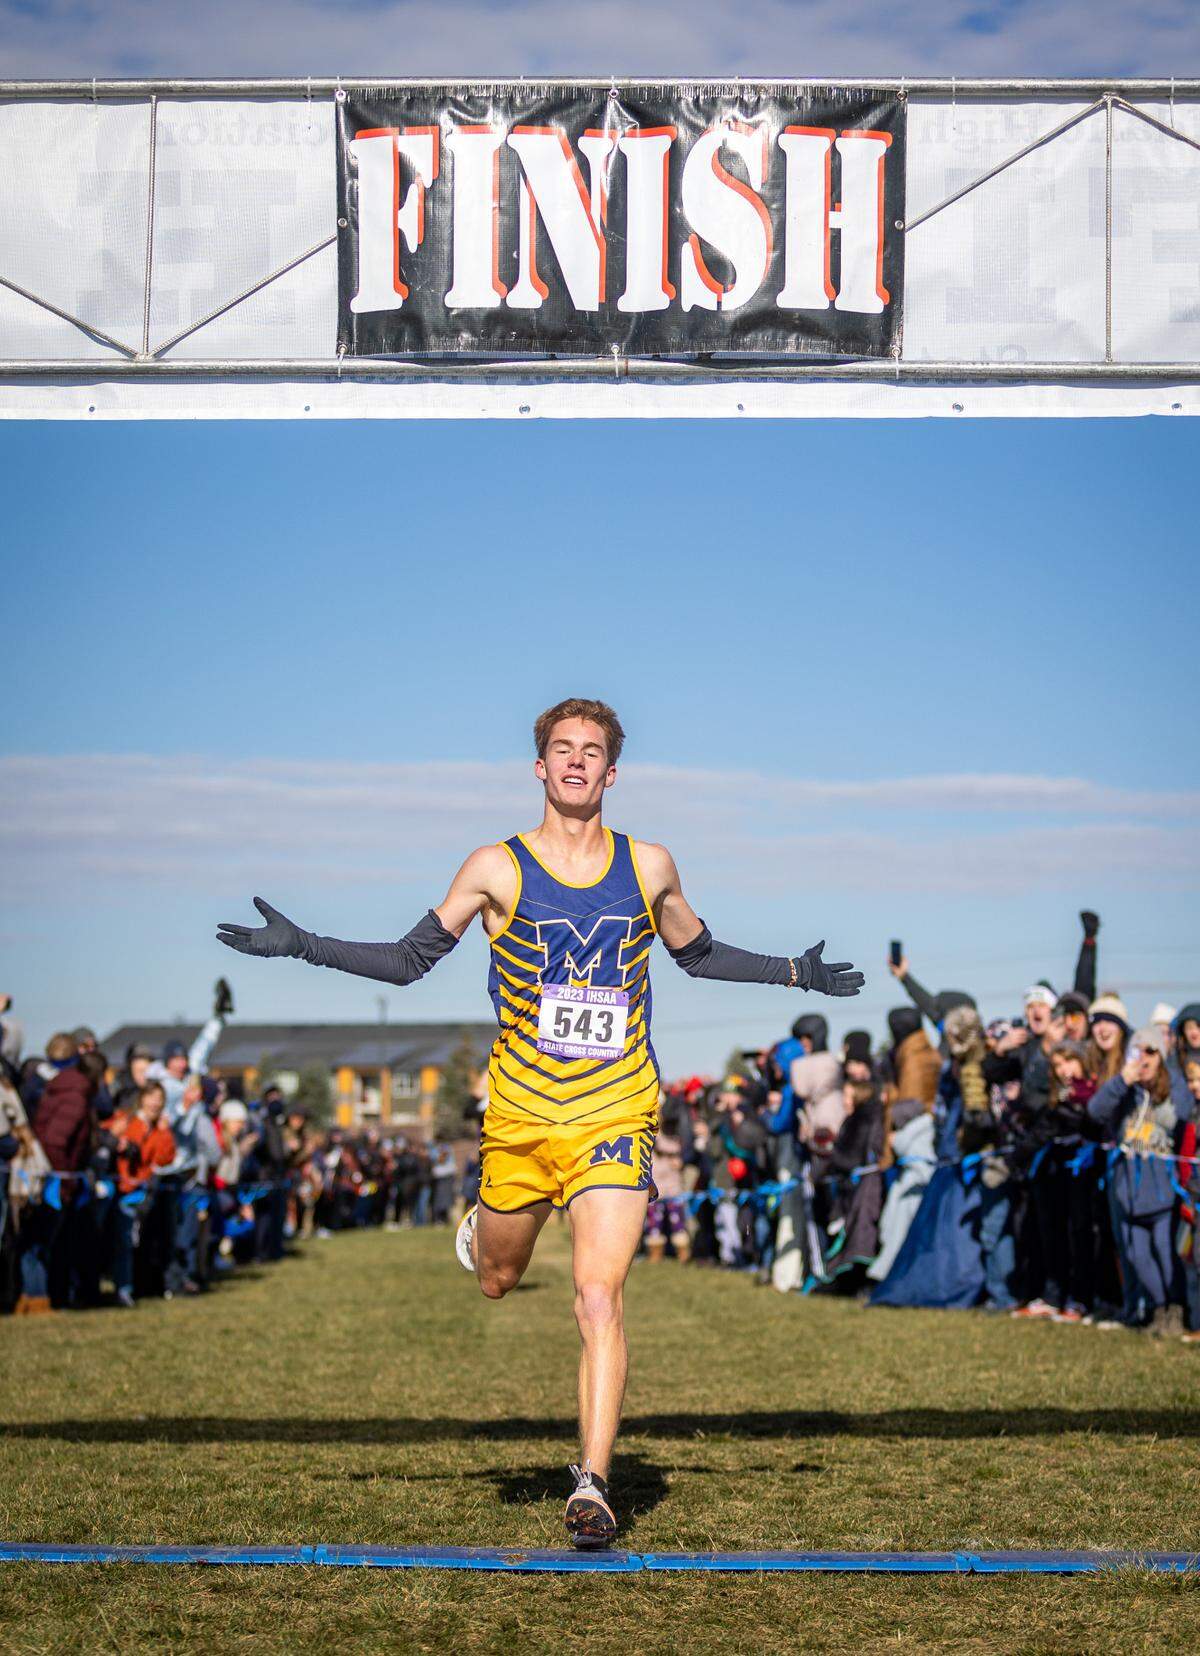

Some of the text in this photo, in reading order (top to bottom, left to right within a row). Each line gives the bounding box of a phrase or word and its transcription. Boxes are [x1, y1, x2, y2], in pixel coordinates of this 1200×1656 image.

[349, 121, 893, 314] FINISH
[535, 916, 633, 989] M
[556, 987, 617, 1005] 2023 IHSAA
[553, 1006, 614, 1043] 543
[544, 1041, 619, 1058] STATE CROSS COUNTRY
[589, 1134, 634, 1167] M
